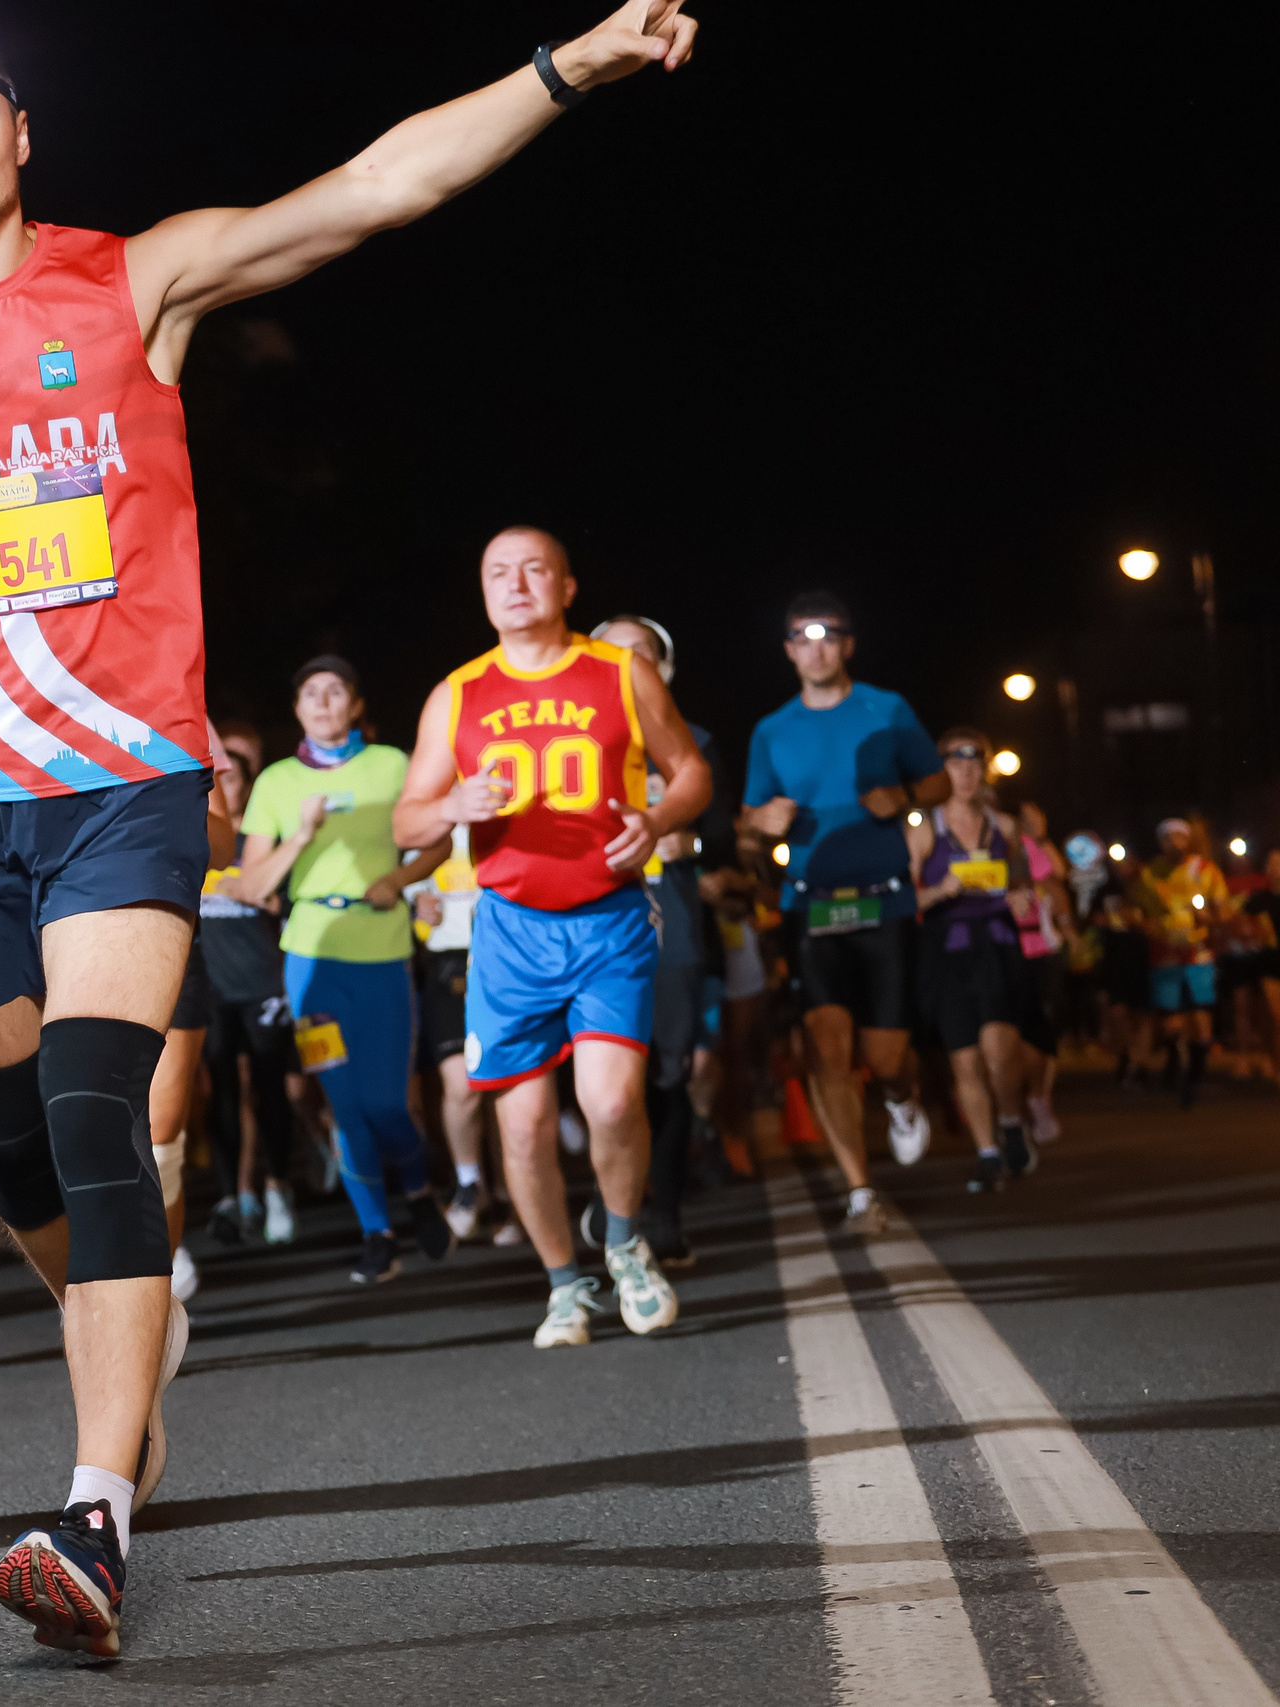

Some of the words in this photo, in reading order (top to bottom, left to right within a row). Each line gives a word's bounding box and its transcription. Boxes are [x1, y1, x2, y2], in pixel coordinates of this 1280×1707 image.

[21, 441, 120, 467] MARATHON
[481, 699, 597, 736] TEAM
[477, 733, 603, 816] 00
